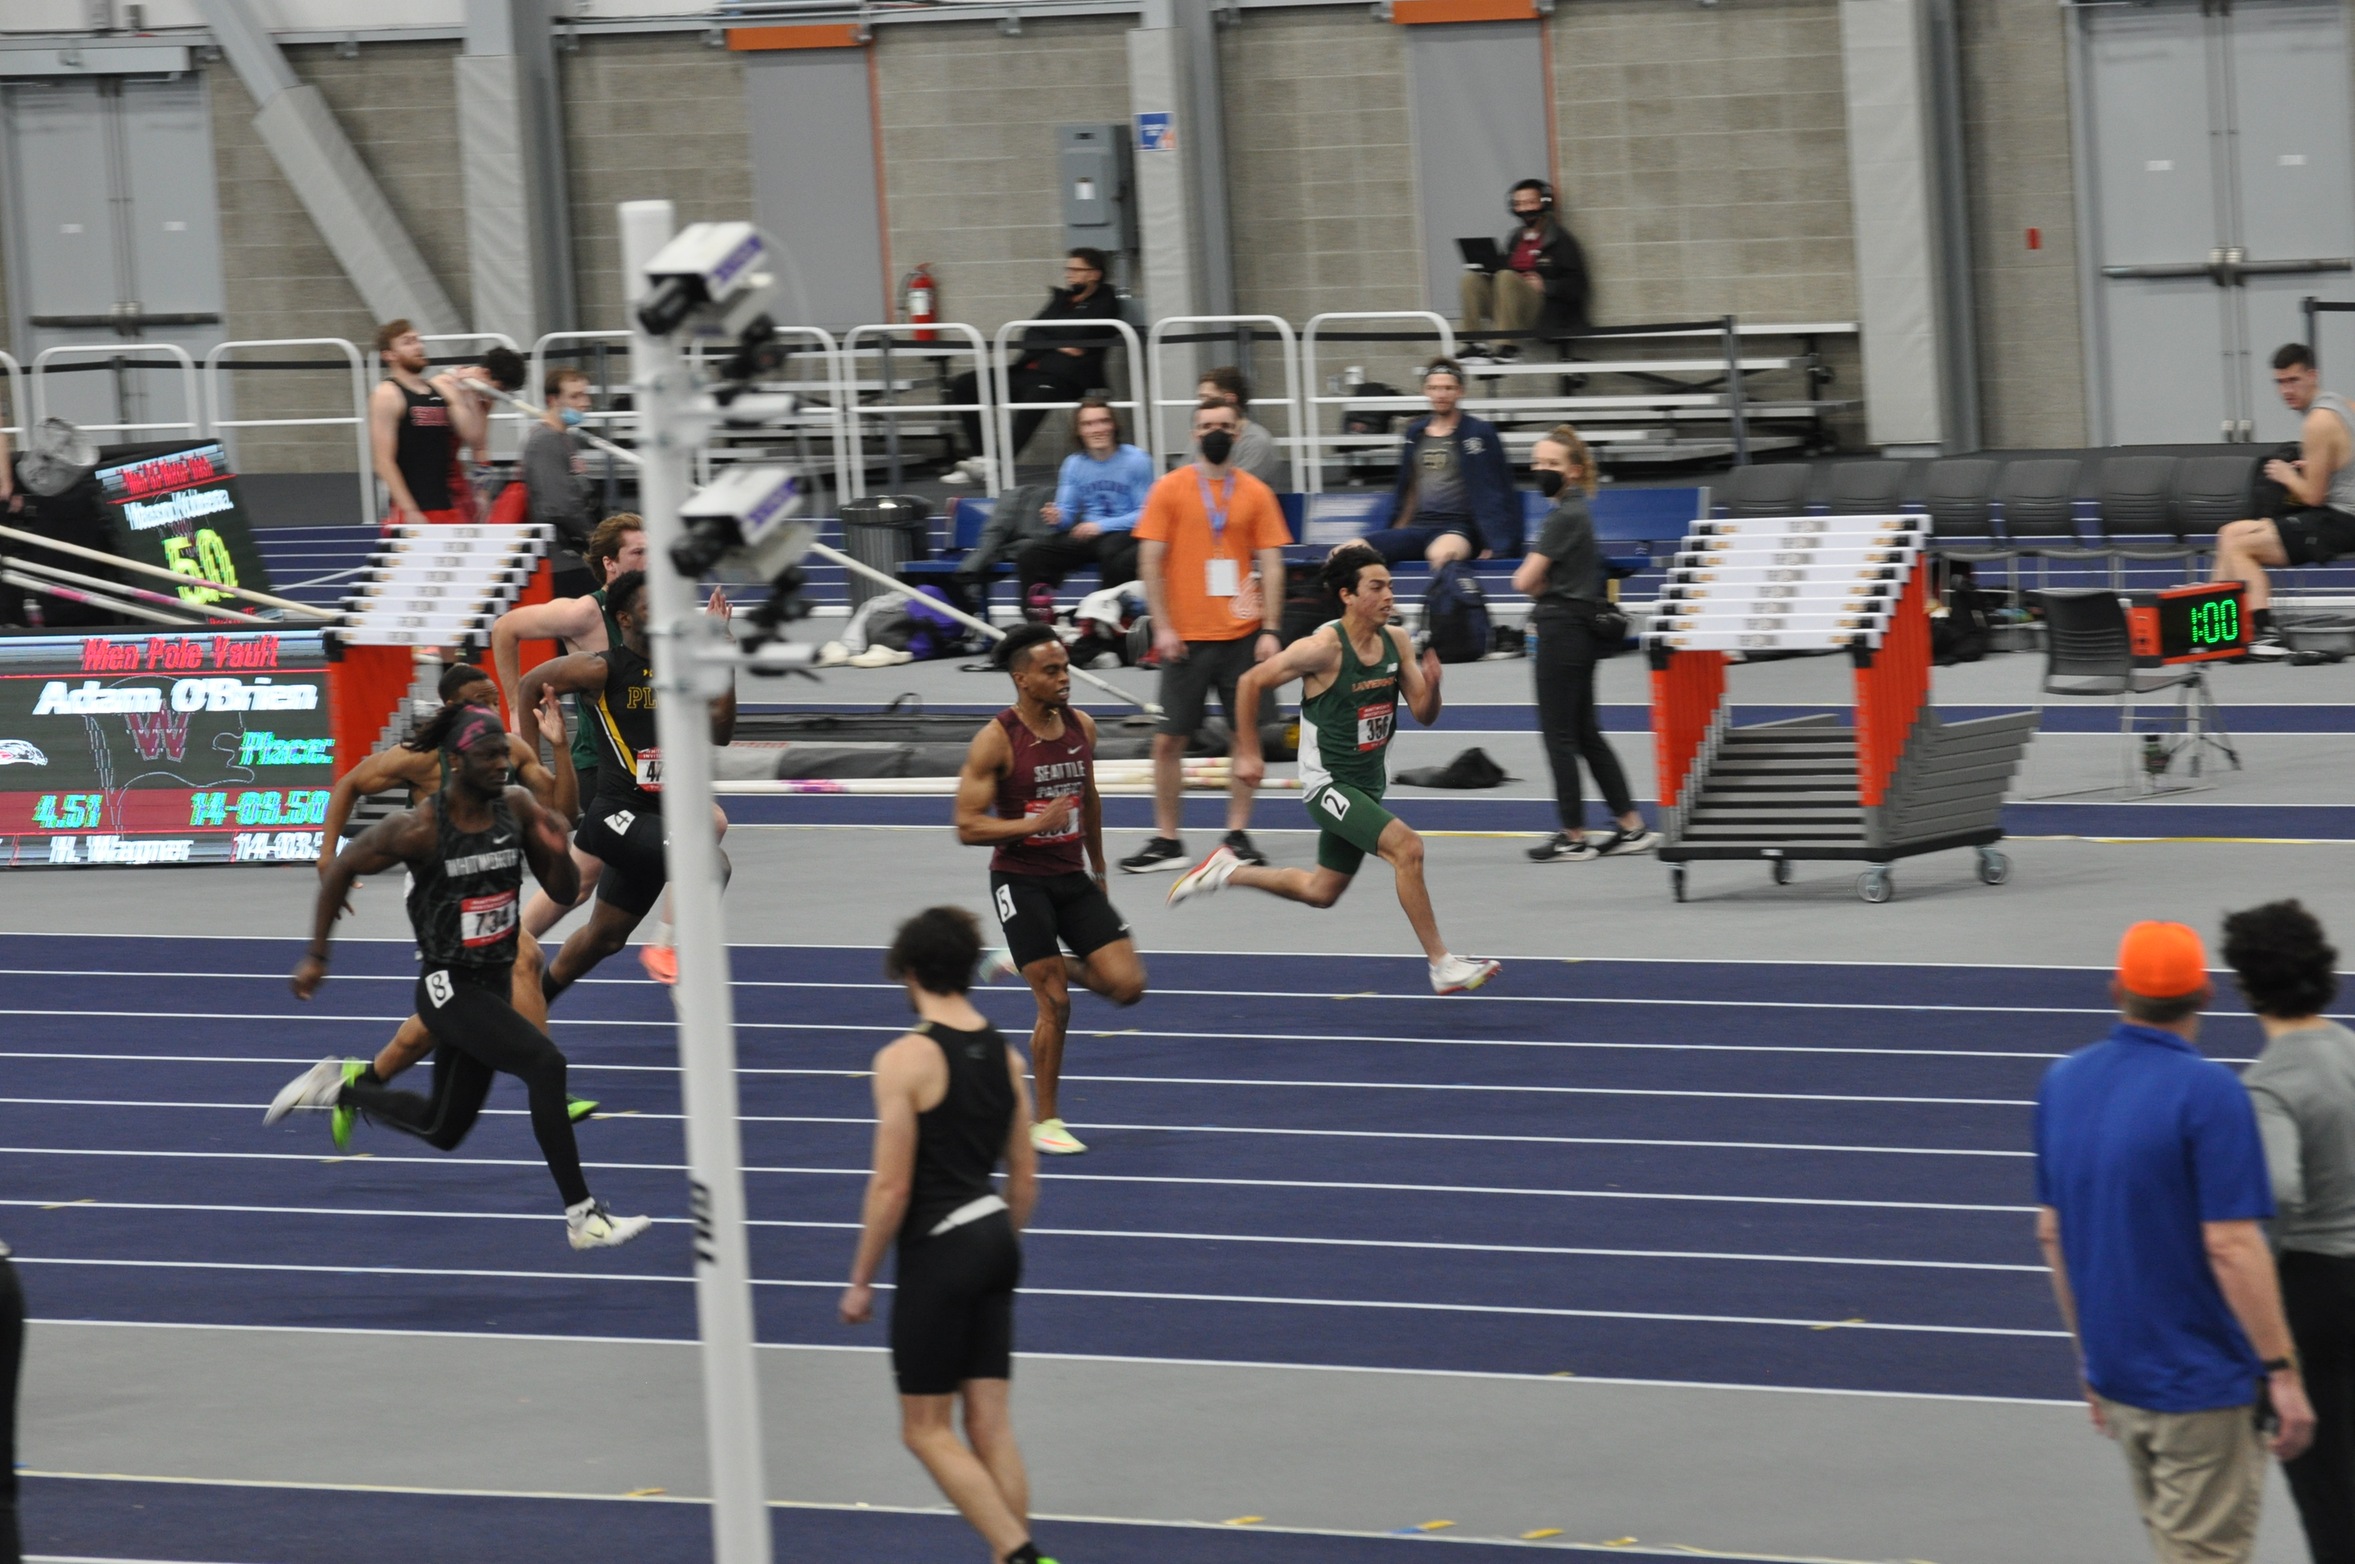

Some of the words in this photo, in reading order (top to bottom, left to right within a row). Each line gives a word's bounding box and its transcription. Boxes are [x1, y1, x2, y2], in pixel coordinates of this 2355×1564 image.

[2191, 599, 2238, 643] 1:00
[83, 637, 140, 671] Men
[146, 636, 203, 670] Pole
[211, 635, 280, 669] Vault
[32, 680, 163, 715] Adam
[627, 686, 661, 709] PL
[1367, 715, 1389, 741] 356
[1034, 760, 1086, 783] SEATTLE
[32, 793, 103, 828] 4.51
[189, 790, 331, 827] 14-09.50
[614, 811, 630, 828] 4
[1324, 794, 1347, 816] 2
[86, 835, 194, 864] Wagner
[444, 847, 519, 877] WHITWORTH
[999, 889, 1011, 918] 5
[431, 974, 446, 1000] 8
